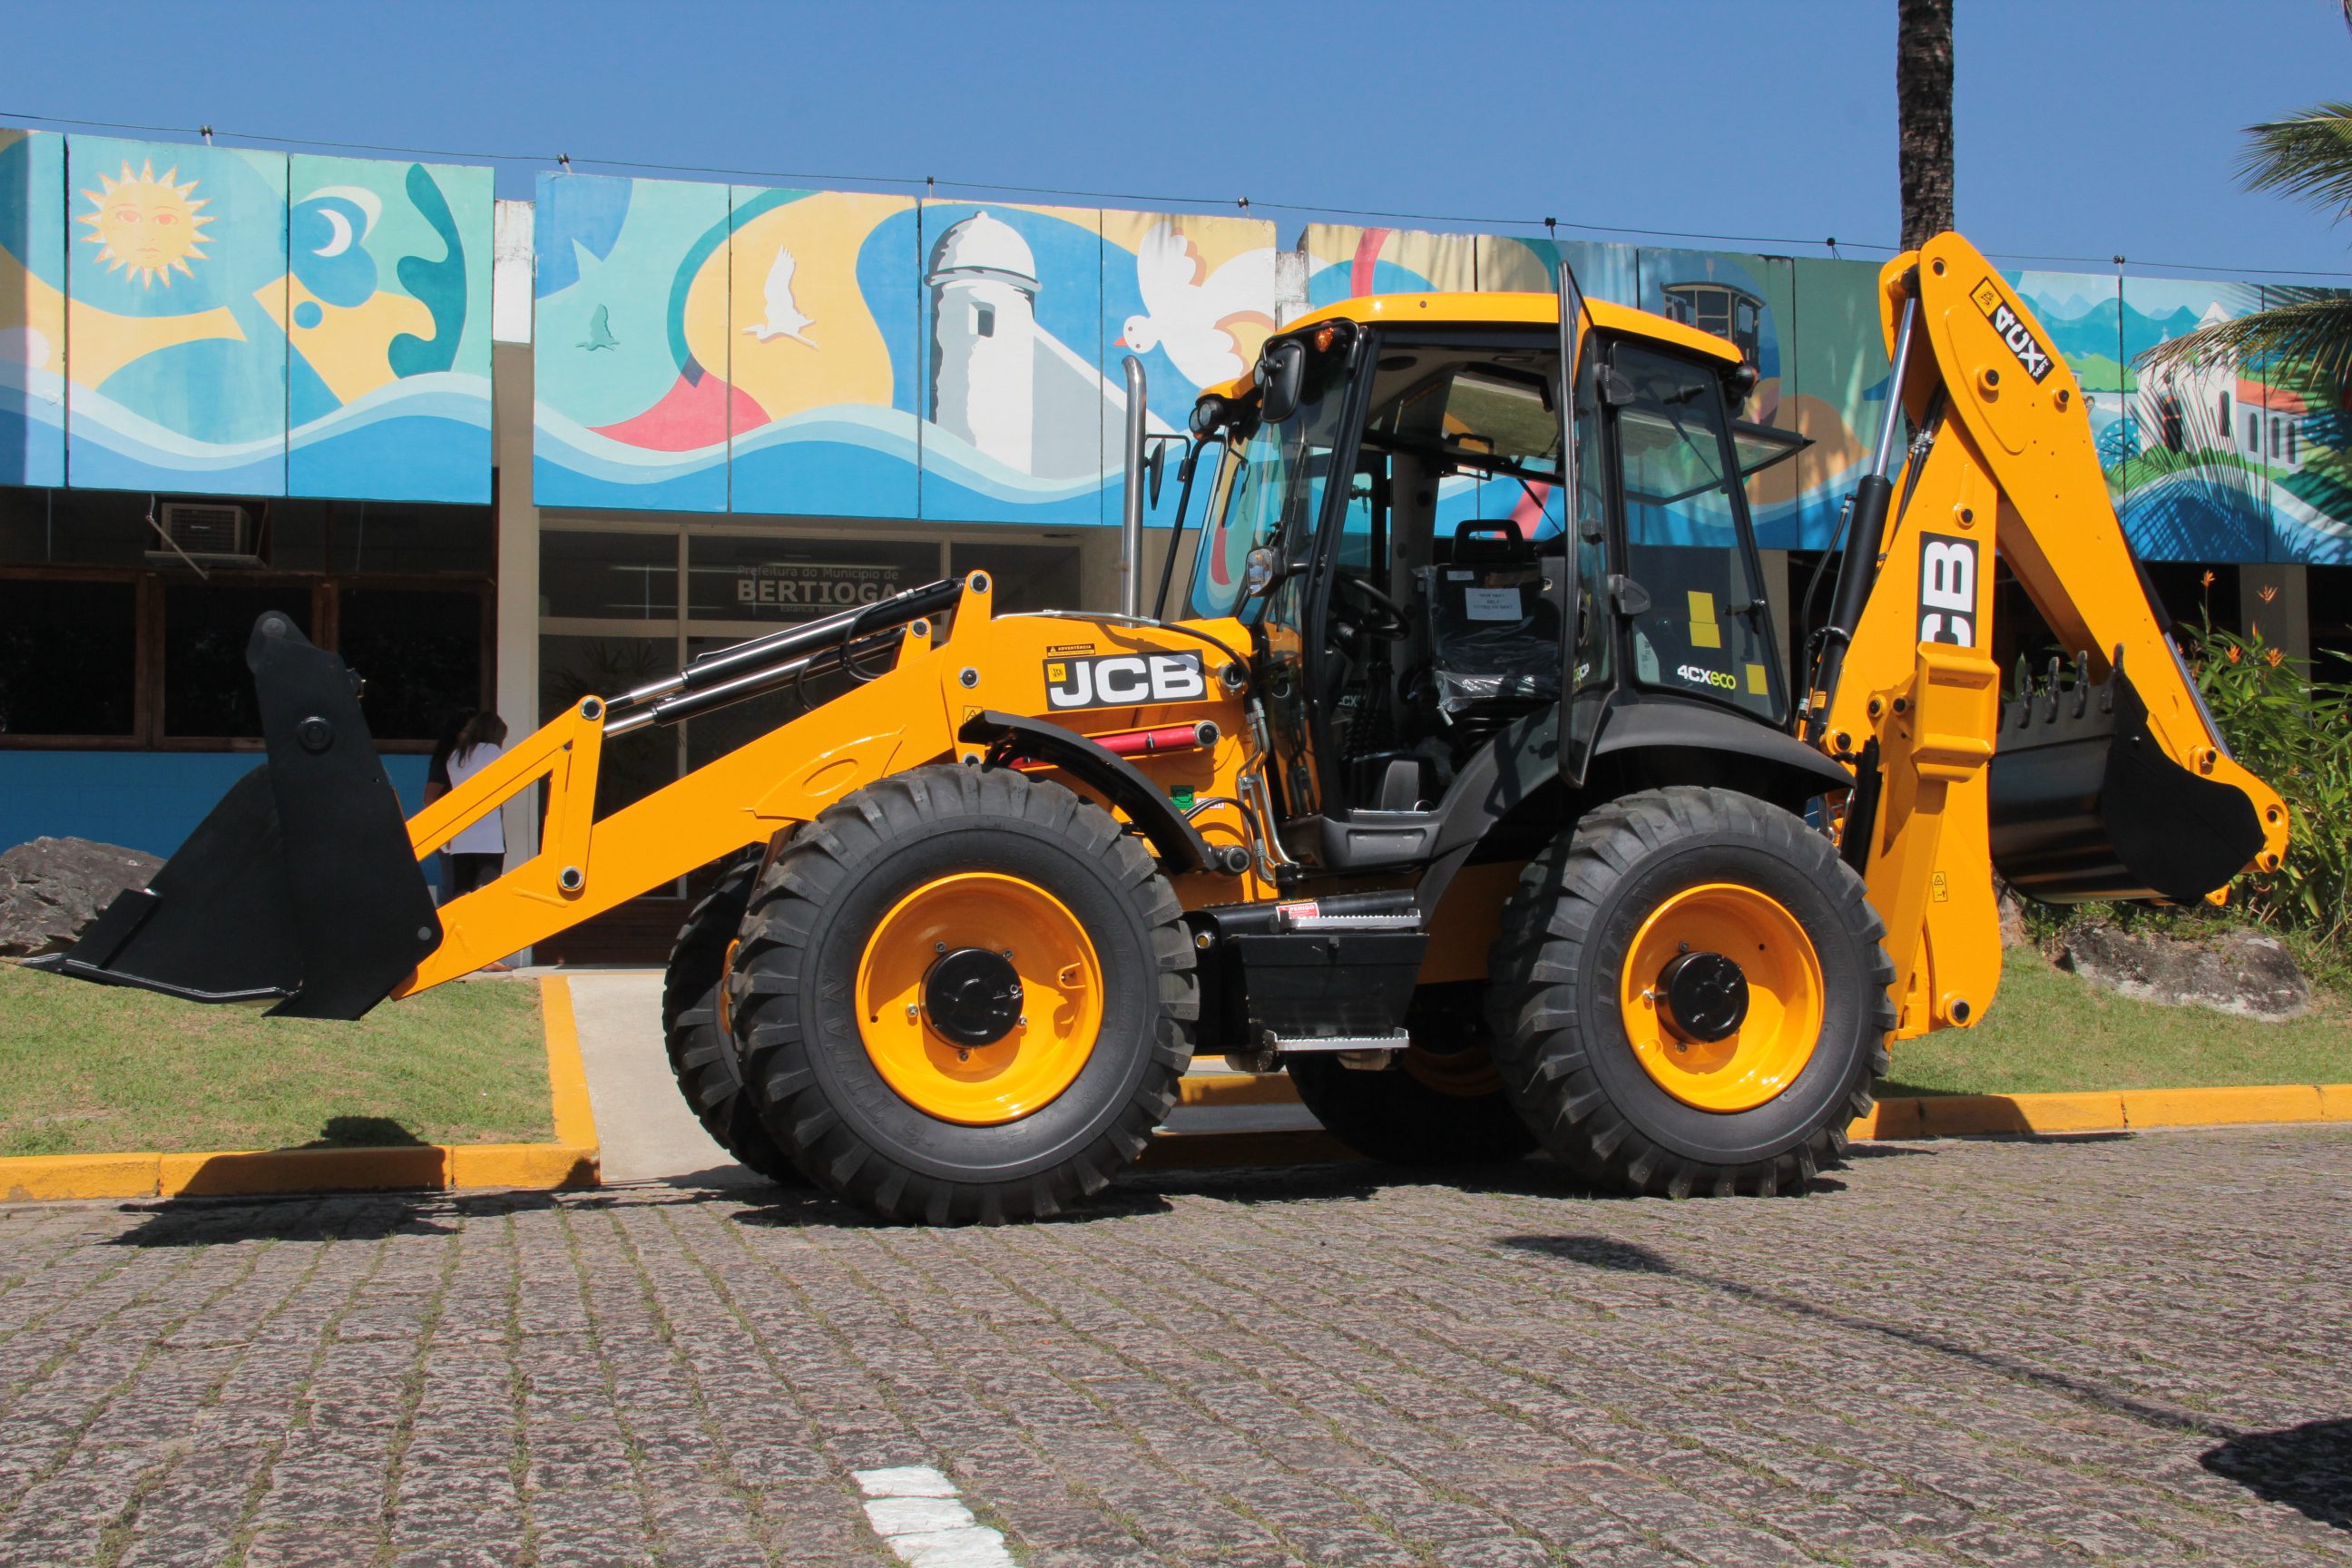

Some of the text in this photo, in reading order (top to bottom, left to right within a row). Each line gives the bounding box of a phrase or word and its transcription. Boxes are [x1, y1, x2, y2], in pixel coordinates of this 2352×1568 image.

[1994, 305, 2046, 374] 4CX
[2032, 358, 2049, 377] 14FT
[737, 564, 799, 577] Prefeitura
[802, 566, 818, 578] do
[884, 569, 899, 580] de
[738, 579, 897, 604] BERTIOGA
[1049, 653, 1205, 707] JCB
[1677, 664, 1737, 690] 4CXeco
[821, 975, 895, 1124] TITAN
